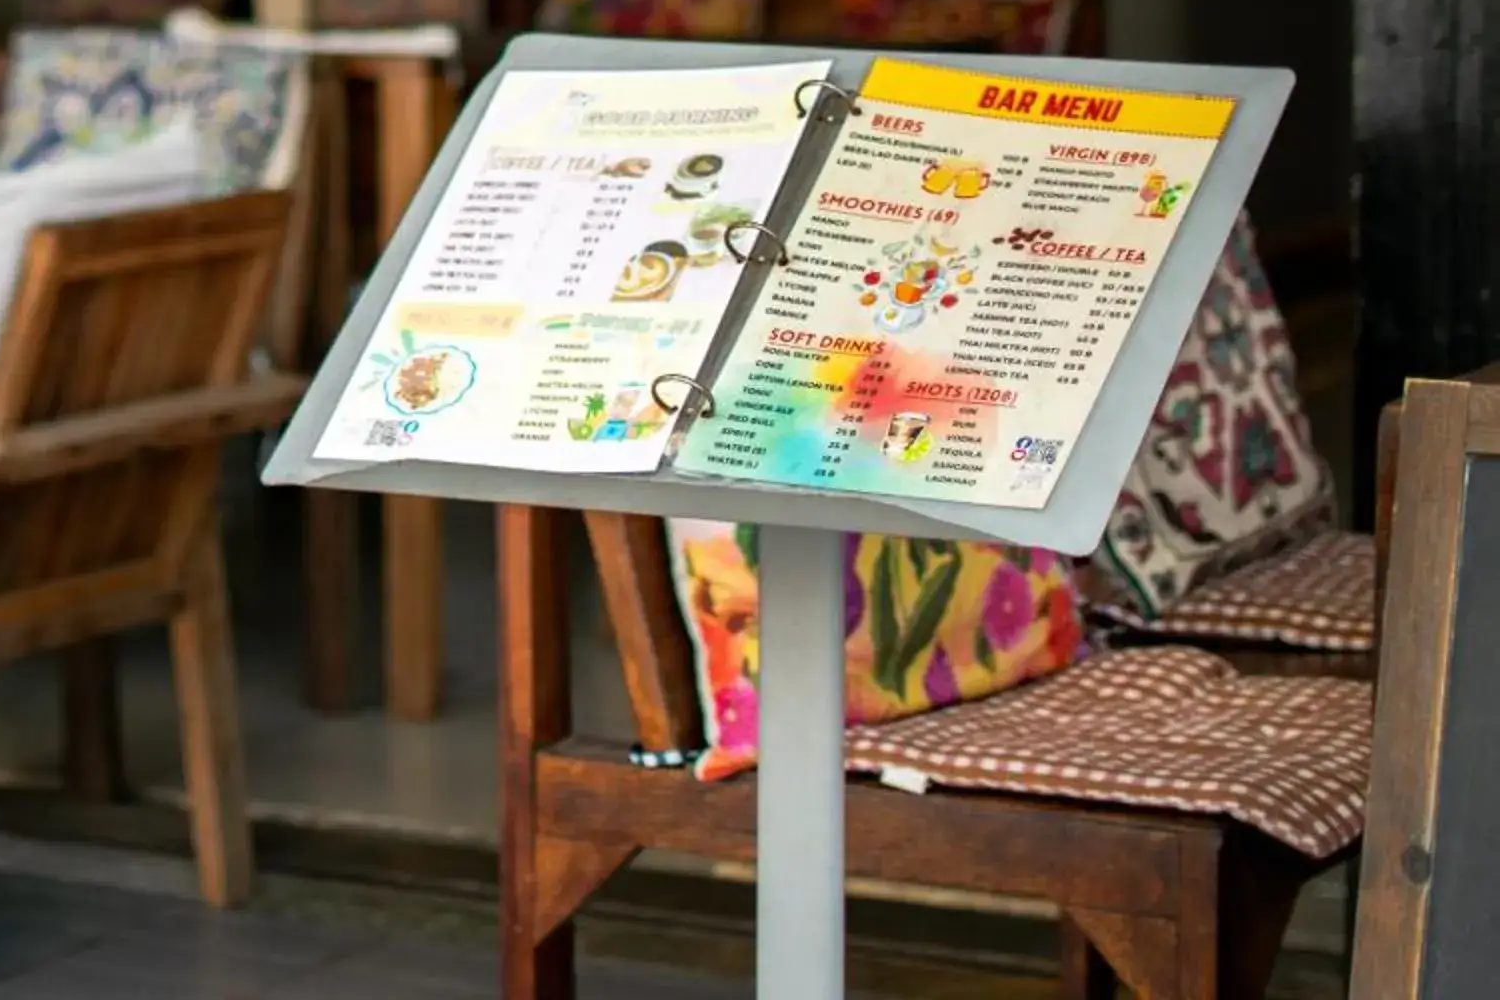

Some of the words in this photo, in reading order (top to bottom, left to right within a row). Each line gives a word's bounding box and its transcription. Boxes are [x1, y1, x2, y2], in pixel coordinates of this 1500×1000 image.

[978, 86, 1038, 114] BAR
[1041, 93, 1124, 123] MENU
[871, 114, 925, 133] BEERS
[1049, 144, 1109, 161] VIRGIN
[1034, 177, 1099, 189] STRAWBERRY
[1028, 189, 1074, 200] COCONUT
[819, 191, 924, 220] SMOOTHIES
[927, 208, 960, 226] (69)
[811, 215, 851, 227] MANGO
[805, 228, 875, 244] STRAWBERRY
[1030, 241, 1093, 259] COFFEE
[1117, 248, 1145, 263] TEA
[791, 254, 828, 265] WATER
[830, 261, 866, 272] MELON
[785, 267, 840, 283] PINEAPPLE
[990, 273, 1023, 283] BLACK
[1026, 275, 1065, 286] COFFEE
[772, 293, 815, 307] BANANA
[765, 307, 808, 321] ORANGE
[1018, 317, 1037, 325] TEA
[991, 327, 1010, 336] TEA
[768, 327, 816, 346] SOFT
[819, 334, 887, 354] DRINKS
[755, 359, 784, 370] COKE
[1009, 371, 1029, 380] TEA
[787, 377, 823, 389] LEMON
[824, 383, 843, 392] TEA
[905, 381, 963, 398] SHOTS
[727, 413, 749, 422] RED
[750, 416, 775, 427] BULL
[721, 427, 756, 439] SPRITE
[946, 433, 982, 444] VODKA
[713, 441, 751, 453] WATER
[939, 447, 982, 458] TEQUILA
[707, 455, 744, 467] WATER
